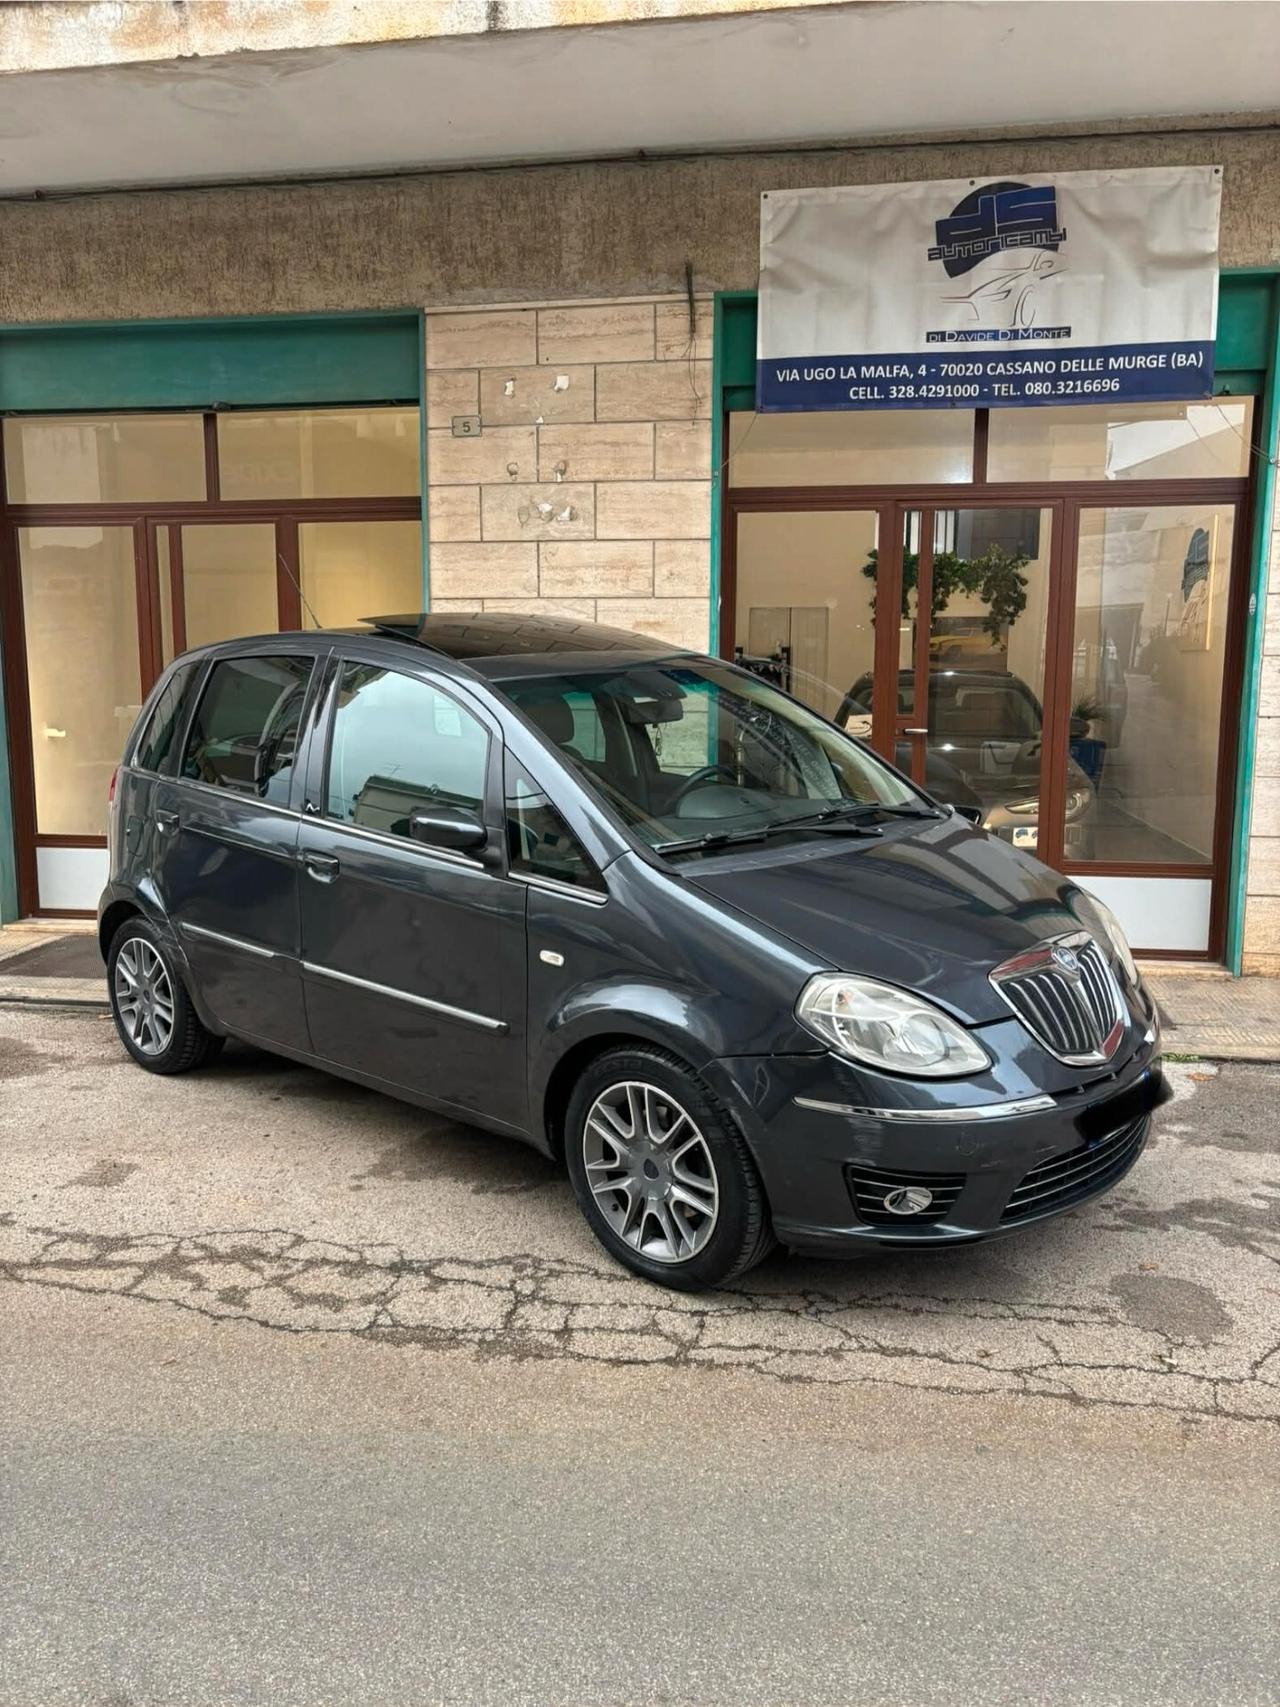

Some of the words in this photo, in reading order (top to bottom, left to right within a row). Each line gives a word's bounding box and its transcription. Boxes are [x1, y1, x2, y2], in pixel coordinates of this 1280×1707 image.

[776, 369, 800, 382] VIA
[803, 367, 836, 381] UGO
[840, 366, 857, 379] LA
[860, 364, 914, 380] MALFA,
[917, 364, 927, 377] 4
[939, 363, 983, 377] 70020
[986, 360, 1056, 376] CASSANO
[1060, 358, 1104, 372] DELLE
[1108, 354, 1167, 370] MURGE
[1171, 351, 1203, 369] (BA)
[849, 386, 884, 400] CELL.
[888, 384, 980, 399] 328.4291000
[992, 383, 1021, 397] TEL.
[1024, 378, 1120, 395] 080.3216696
[462, 421, 471, 433] 5
